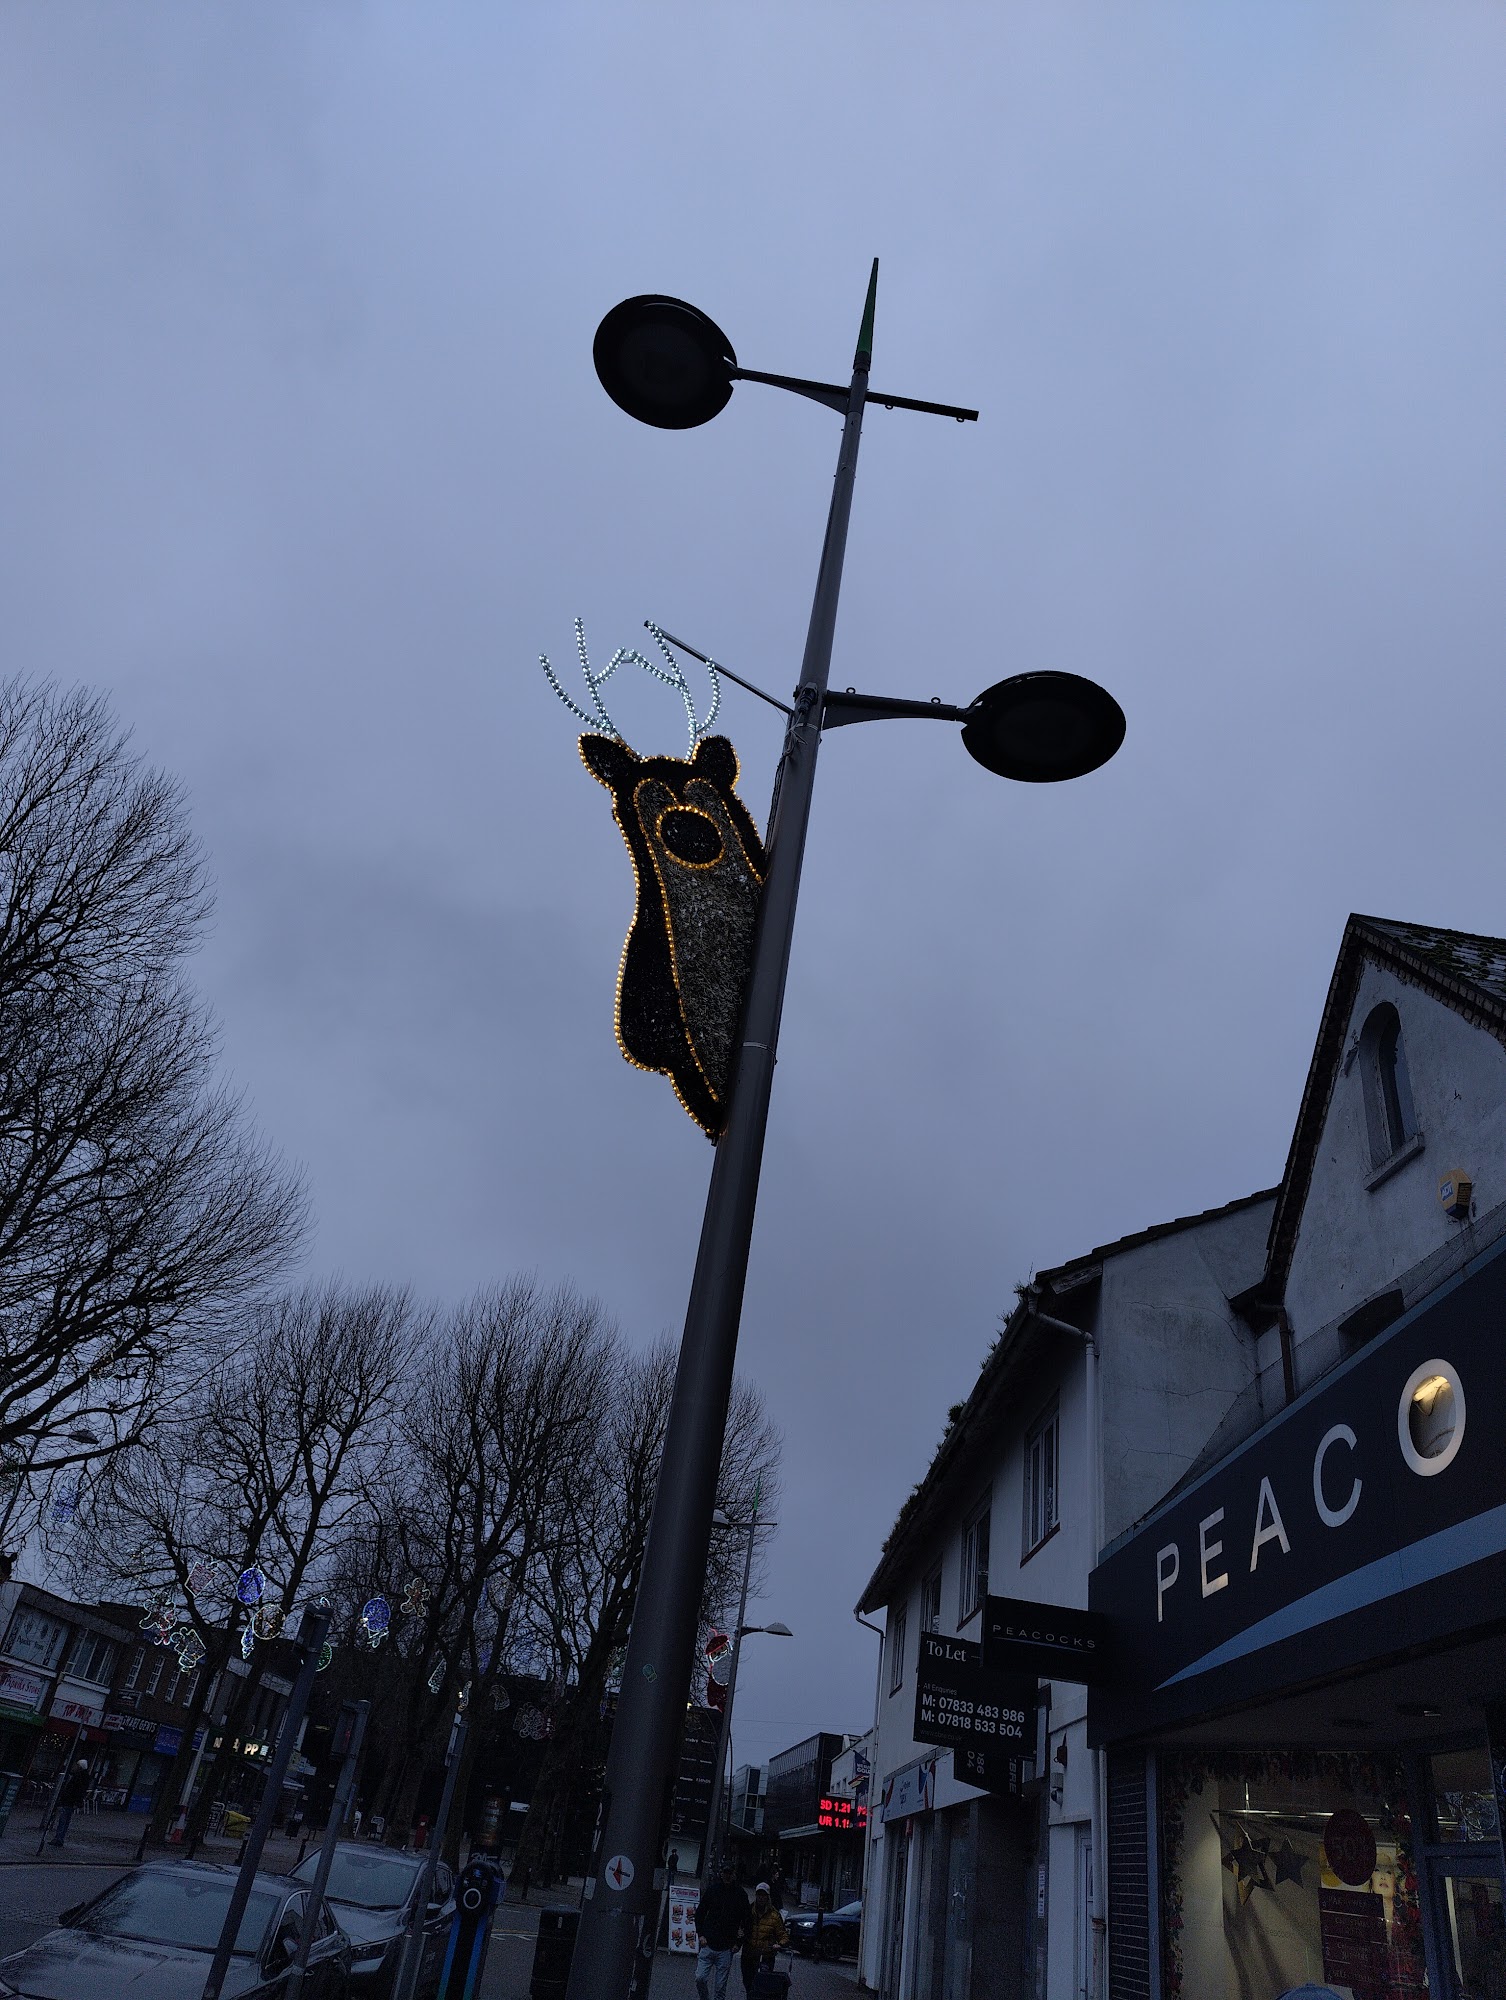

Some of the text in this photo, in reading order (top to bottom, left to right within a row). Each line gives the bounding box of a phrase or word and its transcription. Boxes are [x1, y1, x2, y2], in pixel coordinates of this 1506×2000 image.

[1156, 1358, 1466, 1623] PEACO
[926, 1640, 967, 1662] To Let
[993, 1625, 1096, 1648] PEACOCKS
[922, 1693, 1025, 1723] M: 07833 483 986
[921, 1709, 1023, 1738] M: 07818 533 504
